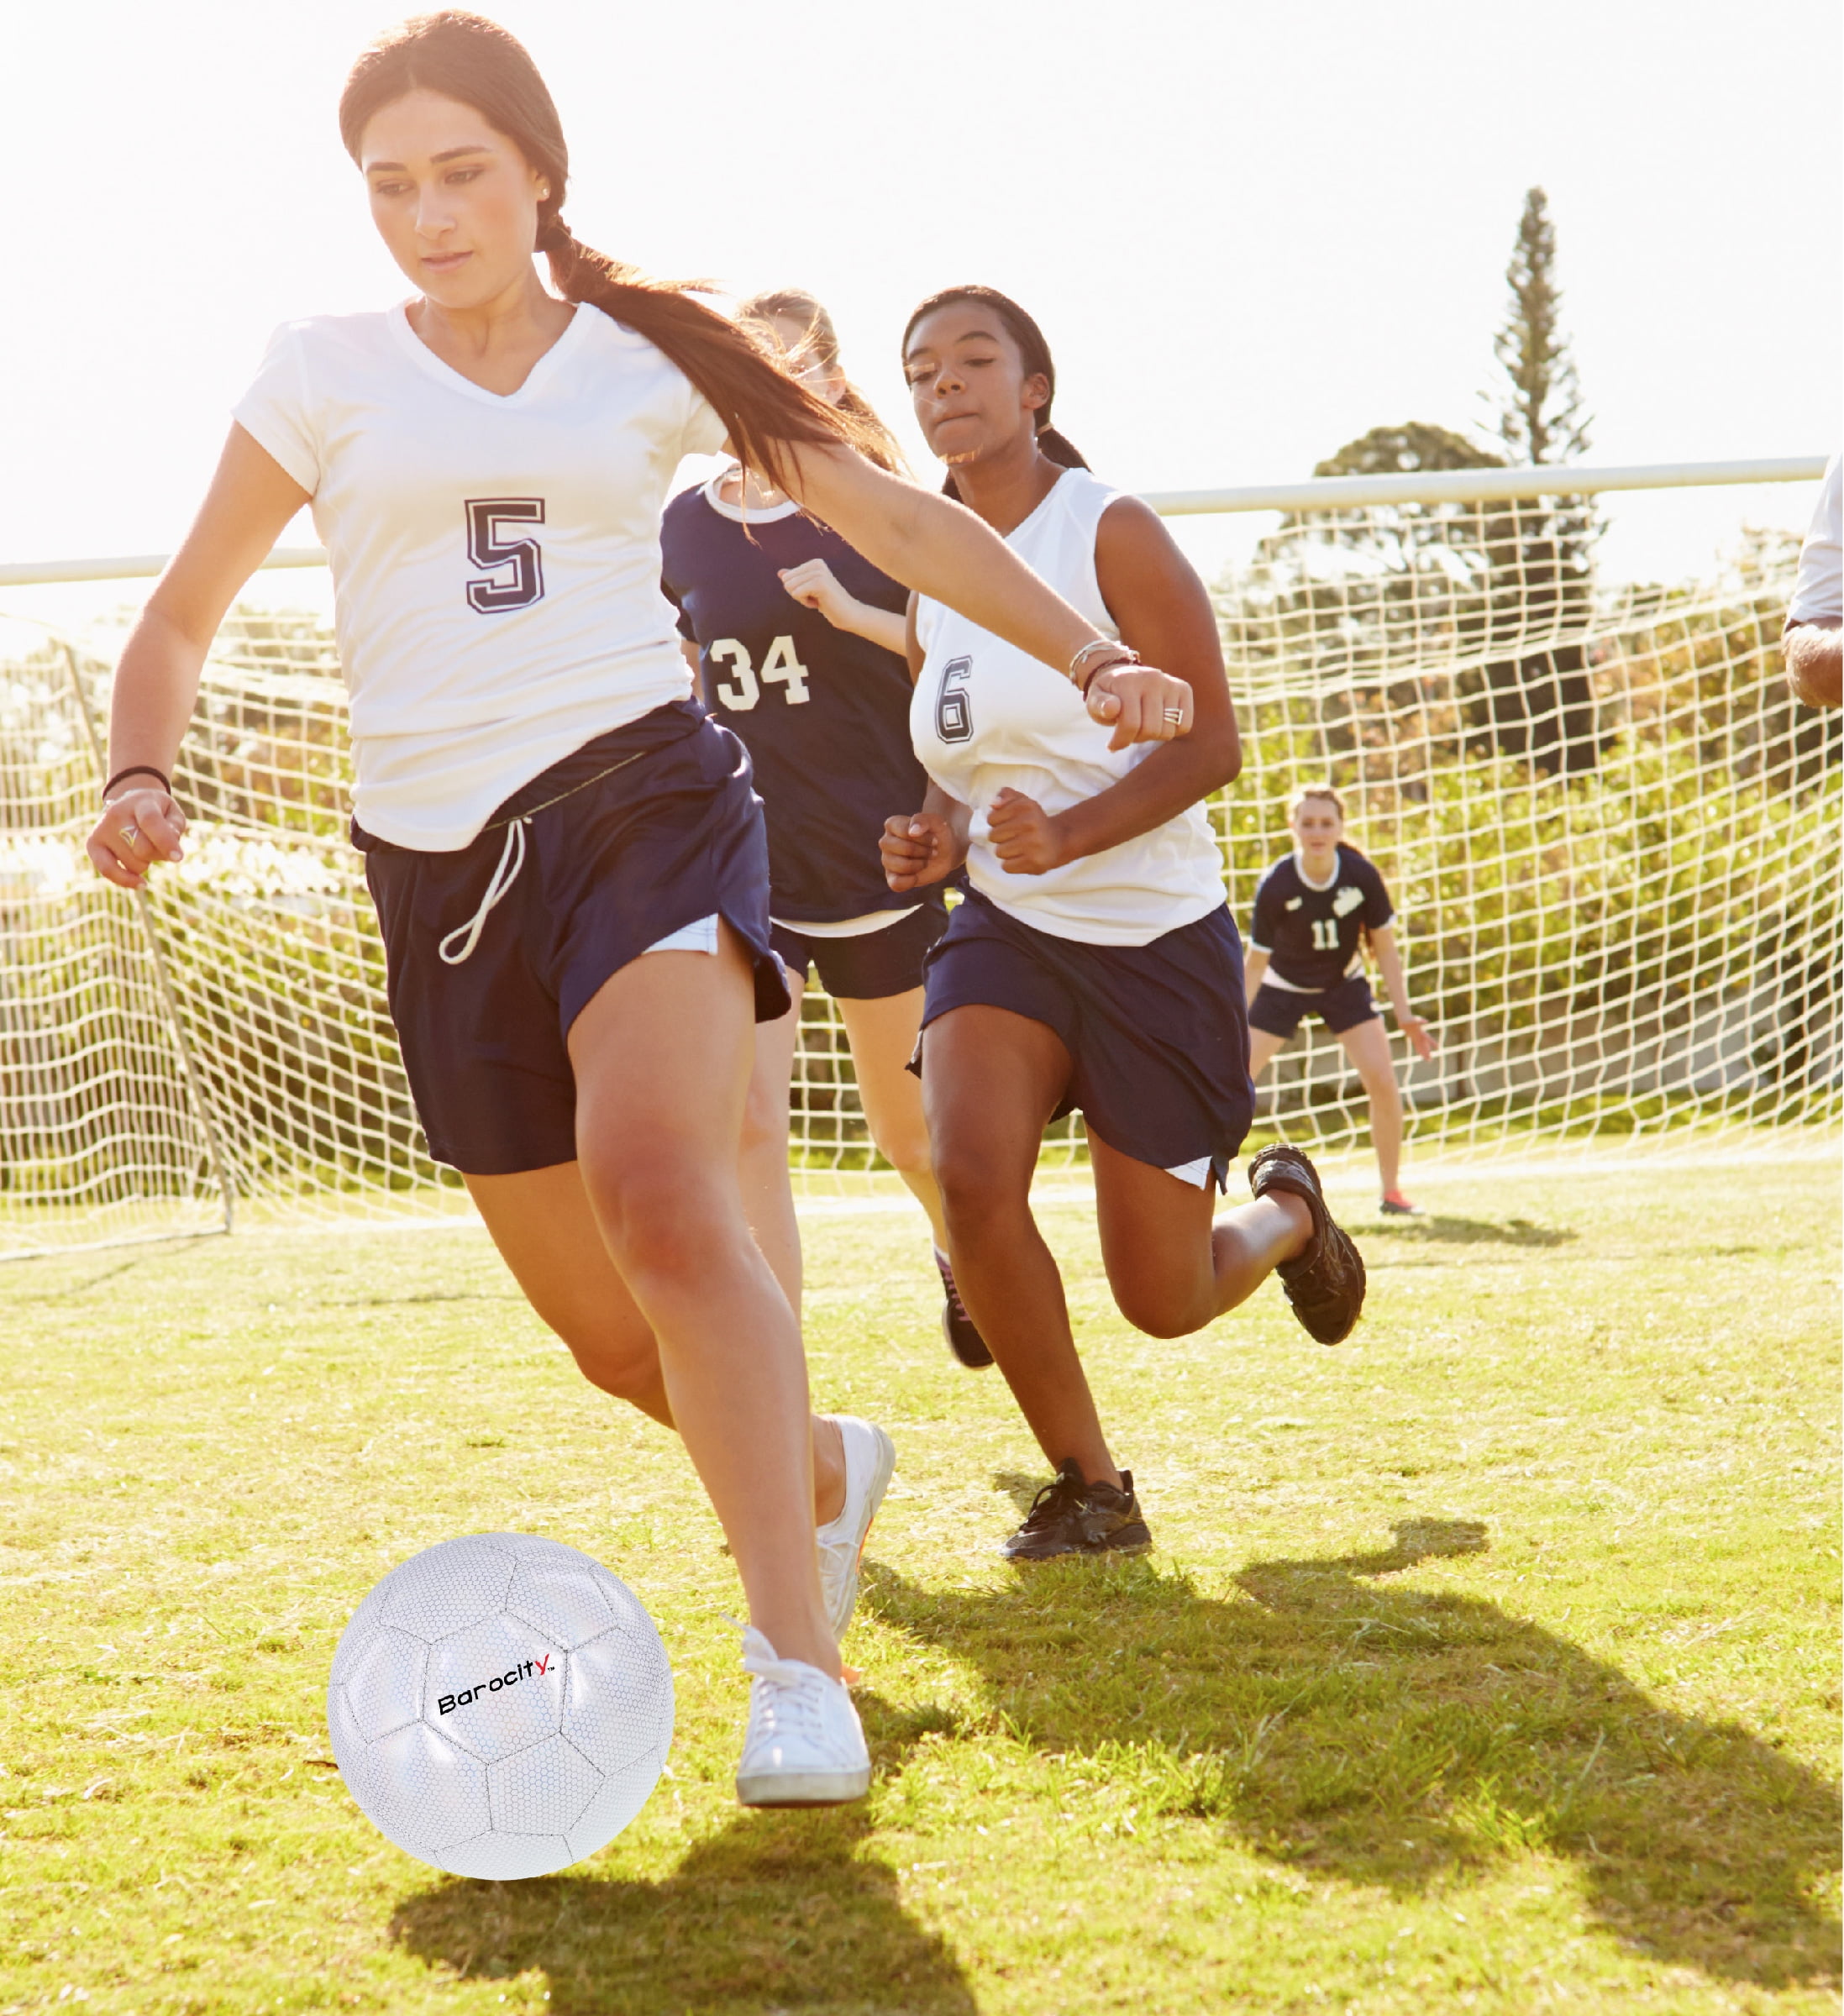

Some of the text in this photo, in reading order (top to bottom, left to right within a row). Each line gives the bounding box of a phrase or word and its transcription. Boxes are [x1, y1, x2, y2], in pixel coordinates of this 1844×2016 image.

[464, 497, 545, 614] 5
[710, 635, 810, 711] 34
[935, 654, 975, 744] 6
[1311, 919, 1339, 950] 11
